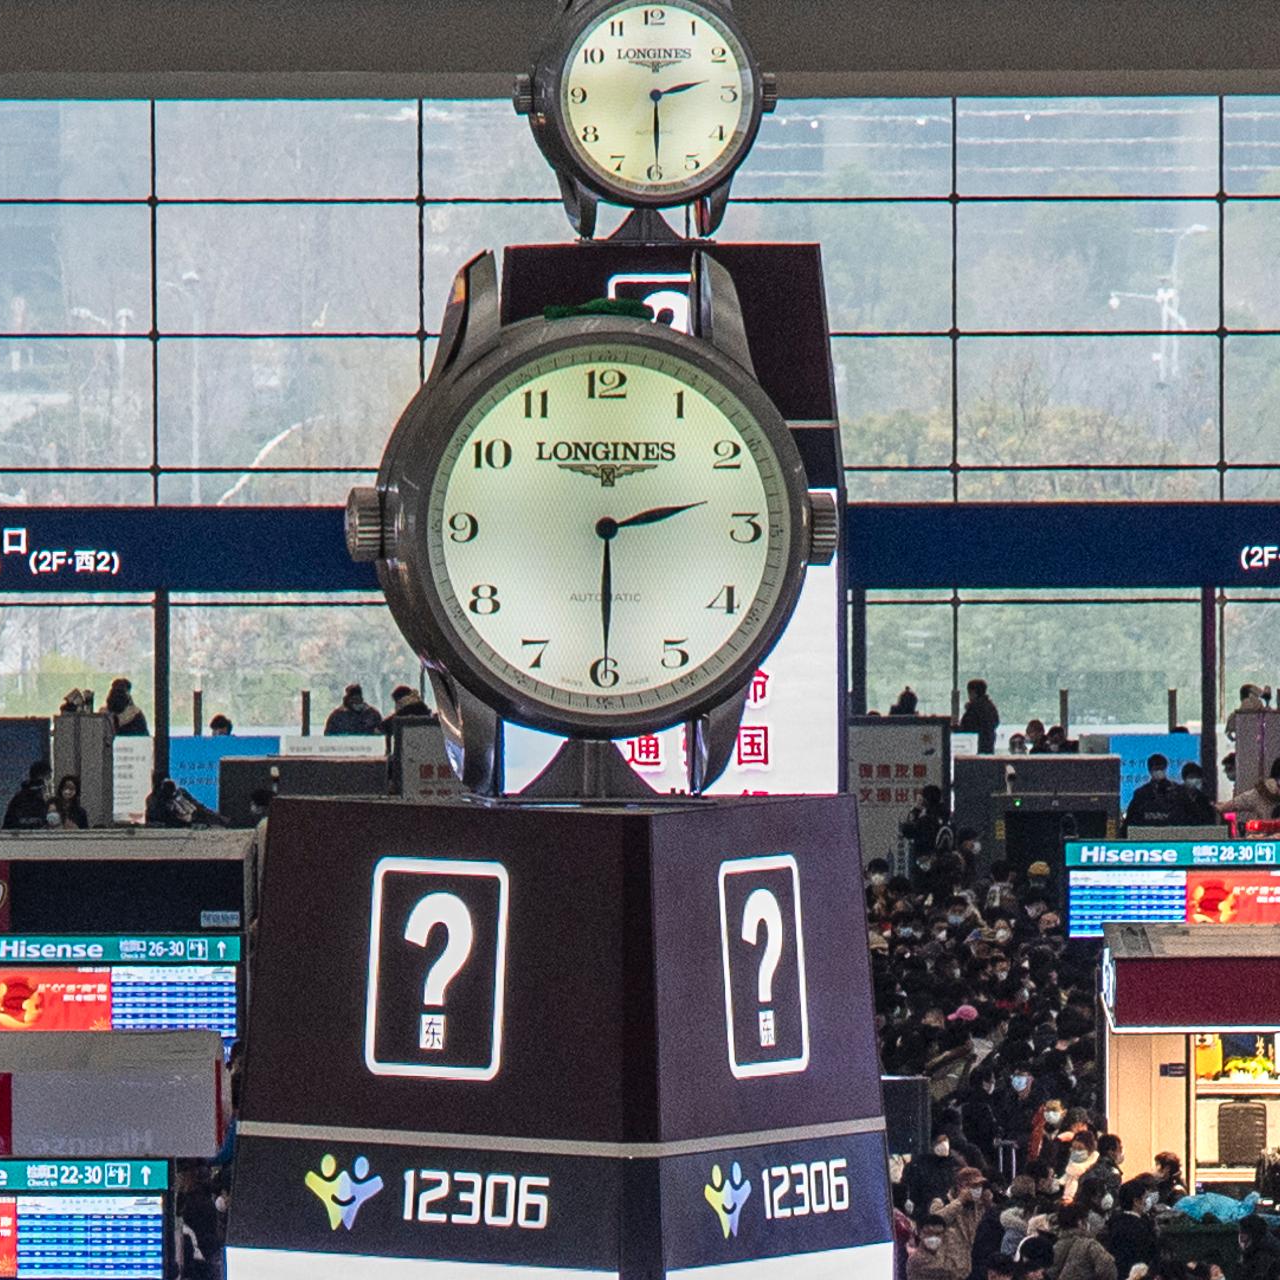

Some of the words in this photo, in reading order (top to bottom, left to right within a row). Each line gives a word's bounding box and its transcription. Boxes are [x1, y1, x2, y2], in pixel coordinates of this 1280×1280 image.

[610, 20, 624, 36] 11
[644, 10, 665, 26] 12
[691, 20, 696, 36] 1
[583, 48, 604, 64] 10
[617, 48, 692, 60] LONGINES
[711, 47, 726, 63] 2
[570, 87, 587, 104] 9
[720, 85, 738, 103] 3
[582, 126, 599, 143] 8
[709, 125, 726, 141] 4
[610, 155, 625, 172] 7
[647, 164, 662, 181] 6
[684, 154, 700, 171] 5
[585, 369, 627, 399] 12
[522, 390, 549, 419] 11
[674, 390, 685, 419] 1
[472, 439, 512, 470] 10
[536, 441, 676, 462] LONGINES
[712, 440, 741, 470] 2
[448, 512, 479, 544] 9
[730, 512, 762, 544] 3
[468, 585, 501, 615] 8
[705, 585, 740, 615] 4
[521, 639, 549, 668] 7
[660, 639, 689, 668] 5
[589, 656, 619, 688] 6
[1080, 846, 1178, 863] Hisense
[1220, 846, 1253, 860] 28-30
[0, 939, 104, 958] Hisense
[148, 940, 185, 957] 26-30
[420, 1015, 445, 1049] 东
[60, 1165, 102, 1184] 22-30
[403, 1170, 551, 1229] 12306
[762, 1159, 849, 1221] 12306
